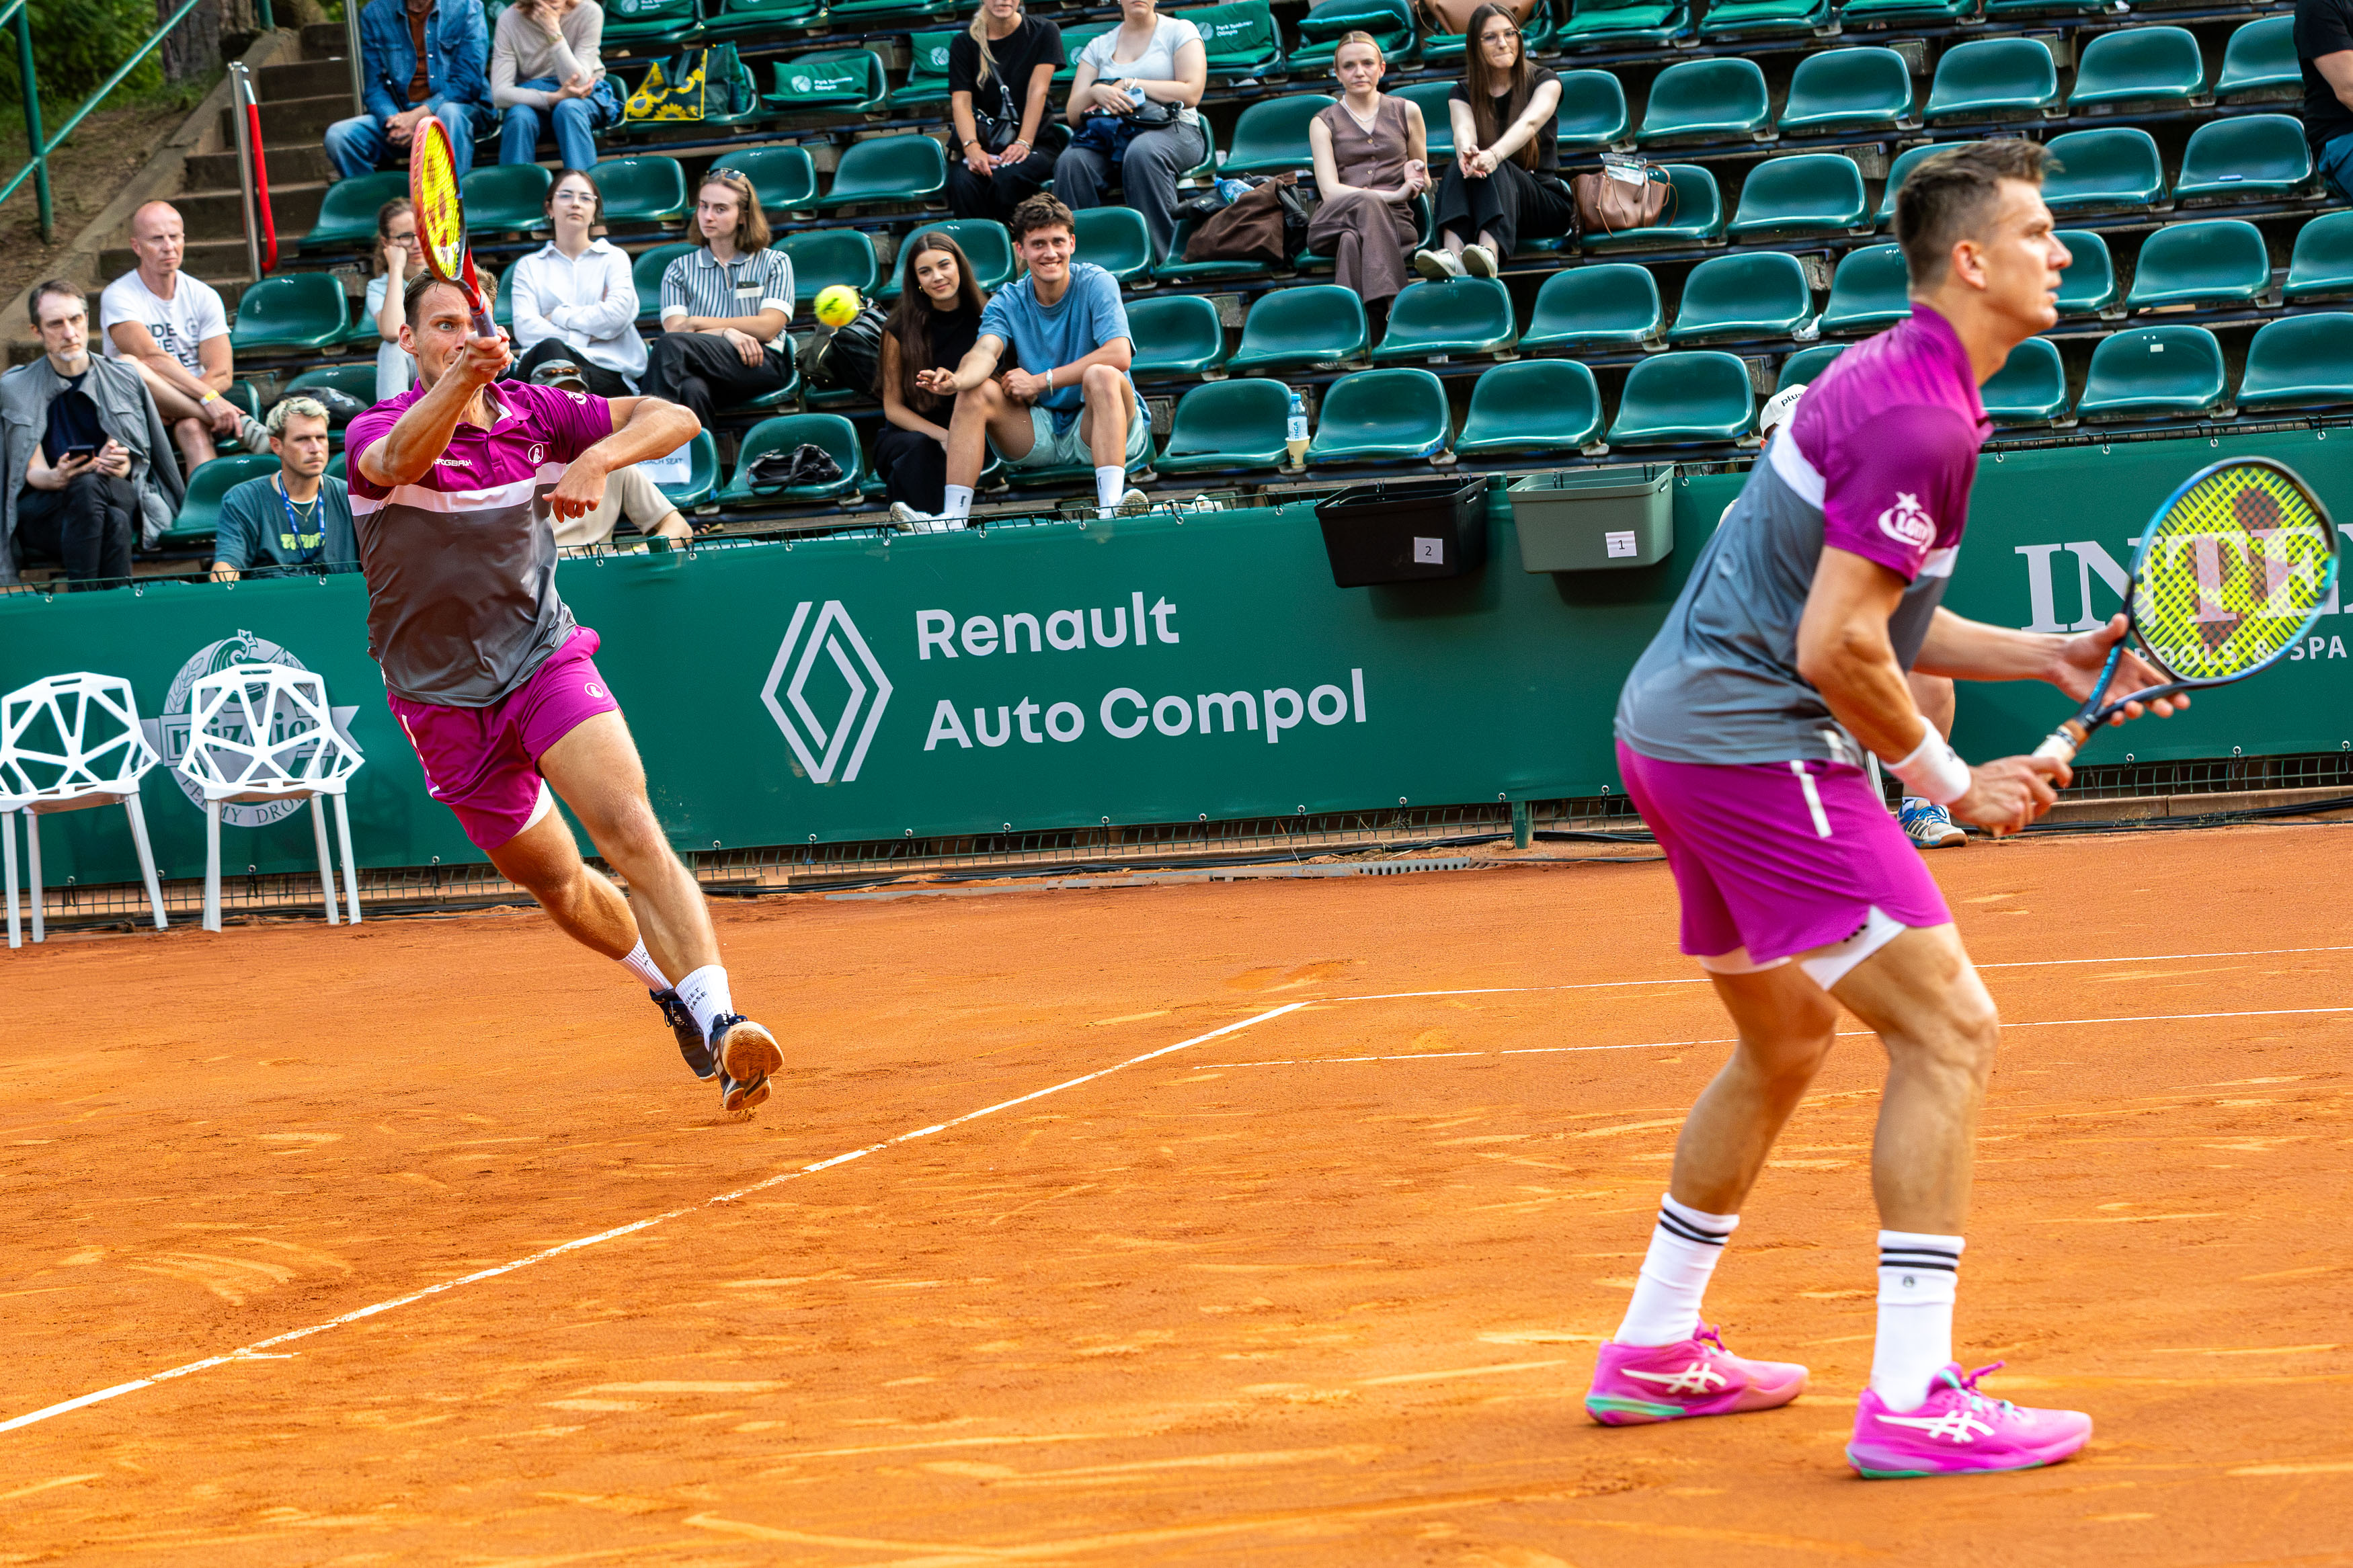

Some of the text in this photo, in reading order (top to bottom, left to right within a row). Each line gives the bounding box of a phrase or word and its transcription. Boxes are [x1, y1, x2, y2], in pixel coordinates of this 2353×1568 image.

[146, 323, 177, 337] DE
[1425, 545, 1433, 556] 2
[1618, 539, 1626, 550] 1
[2014, 522, 2353, 633] INTE
[916, 591, 1180, 660] Renault
[2290, 635, 2348, 661] SPA
[924, 668, 1366, 751] Auto Compol
[690, 991, 707, 1014] EASE
